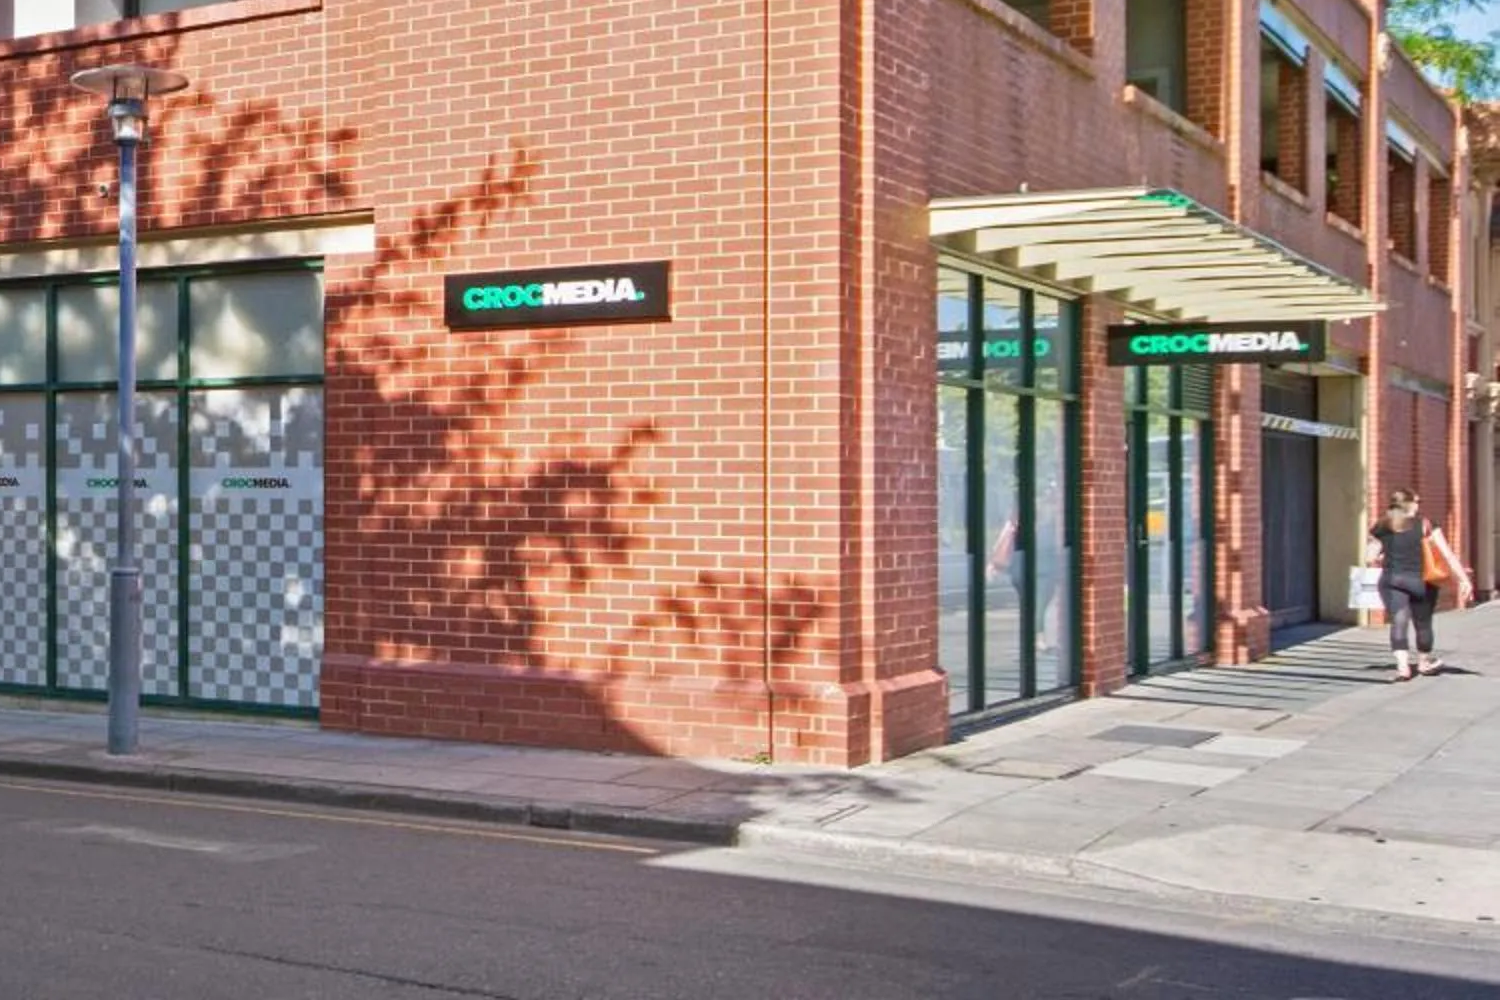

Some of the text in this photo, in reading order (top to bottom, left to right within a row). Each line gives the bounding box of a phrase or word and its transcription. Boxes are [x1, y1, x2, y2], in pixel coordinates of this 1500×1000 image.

[463, 278, 645, 311] CROCMEDIA.
[1129, 331, 1309, 355] CROCMEDIA.
[86, 477, 150, 489] CROCIA.
